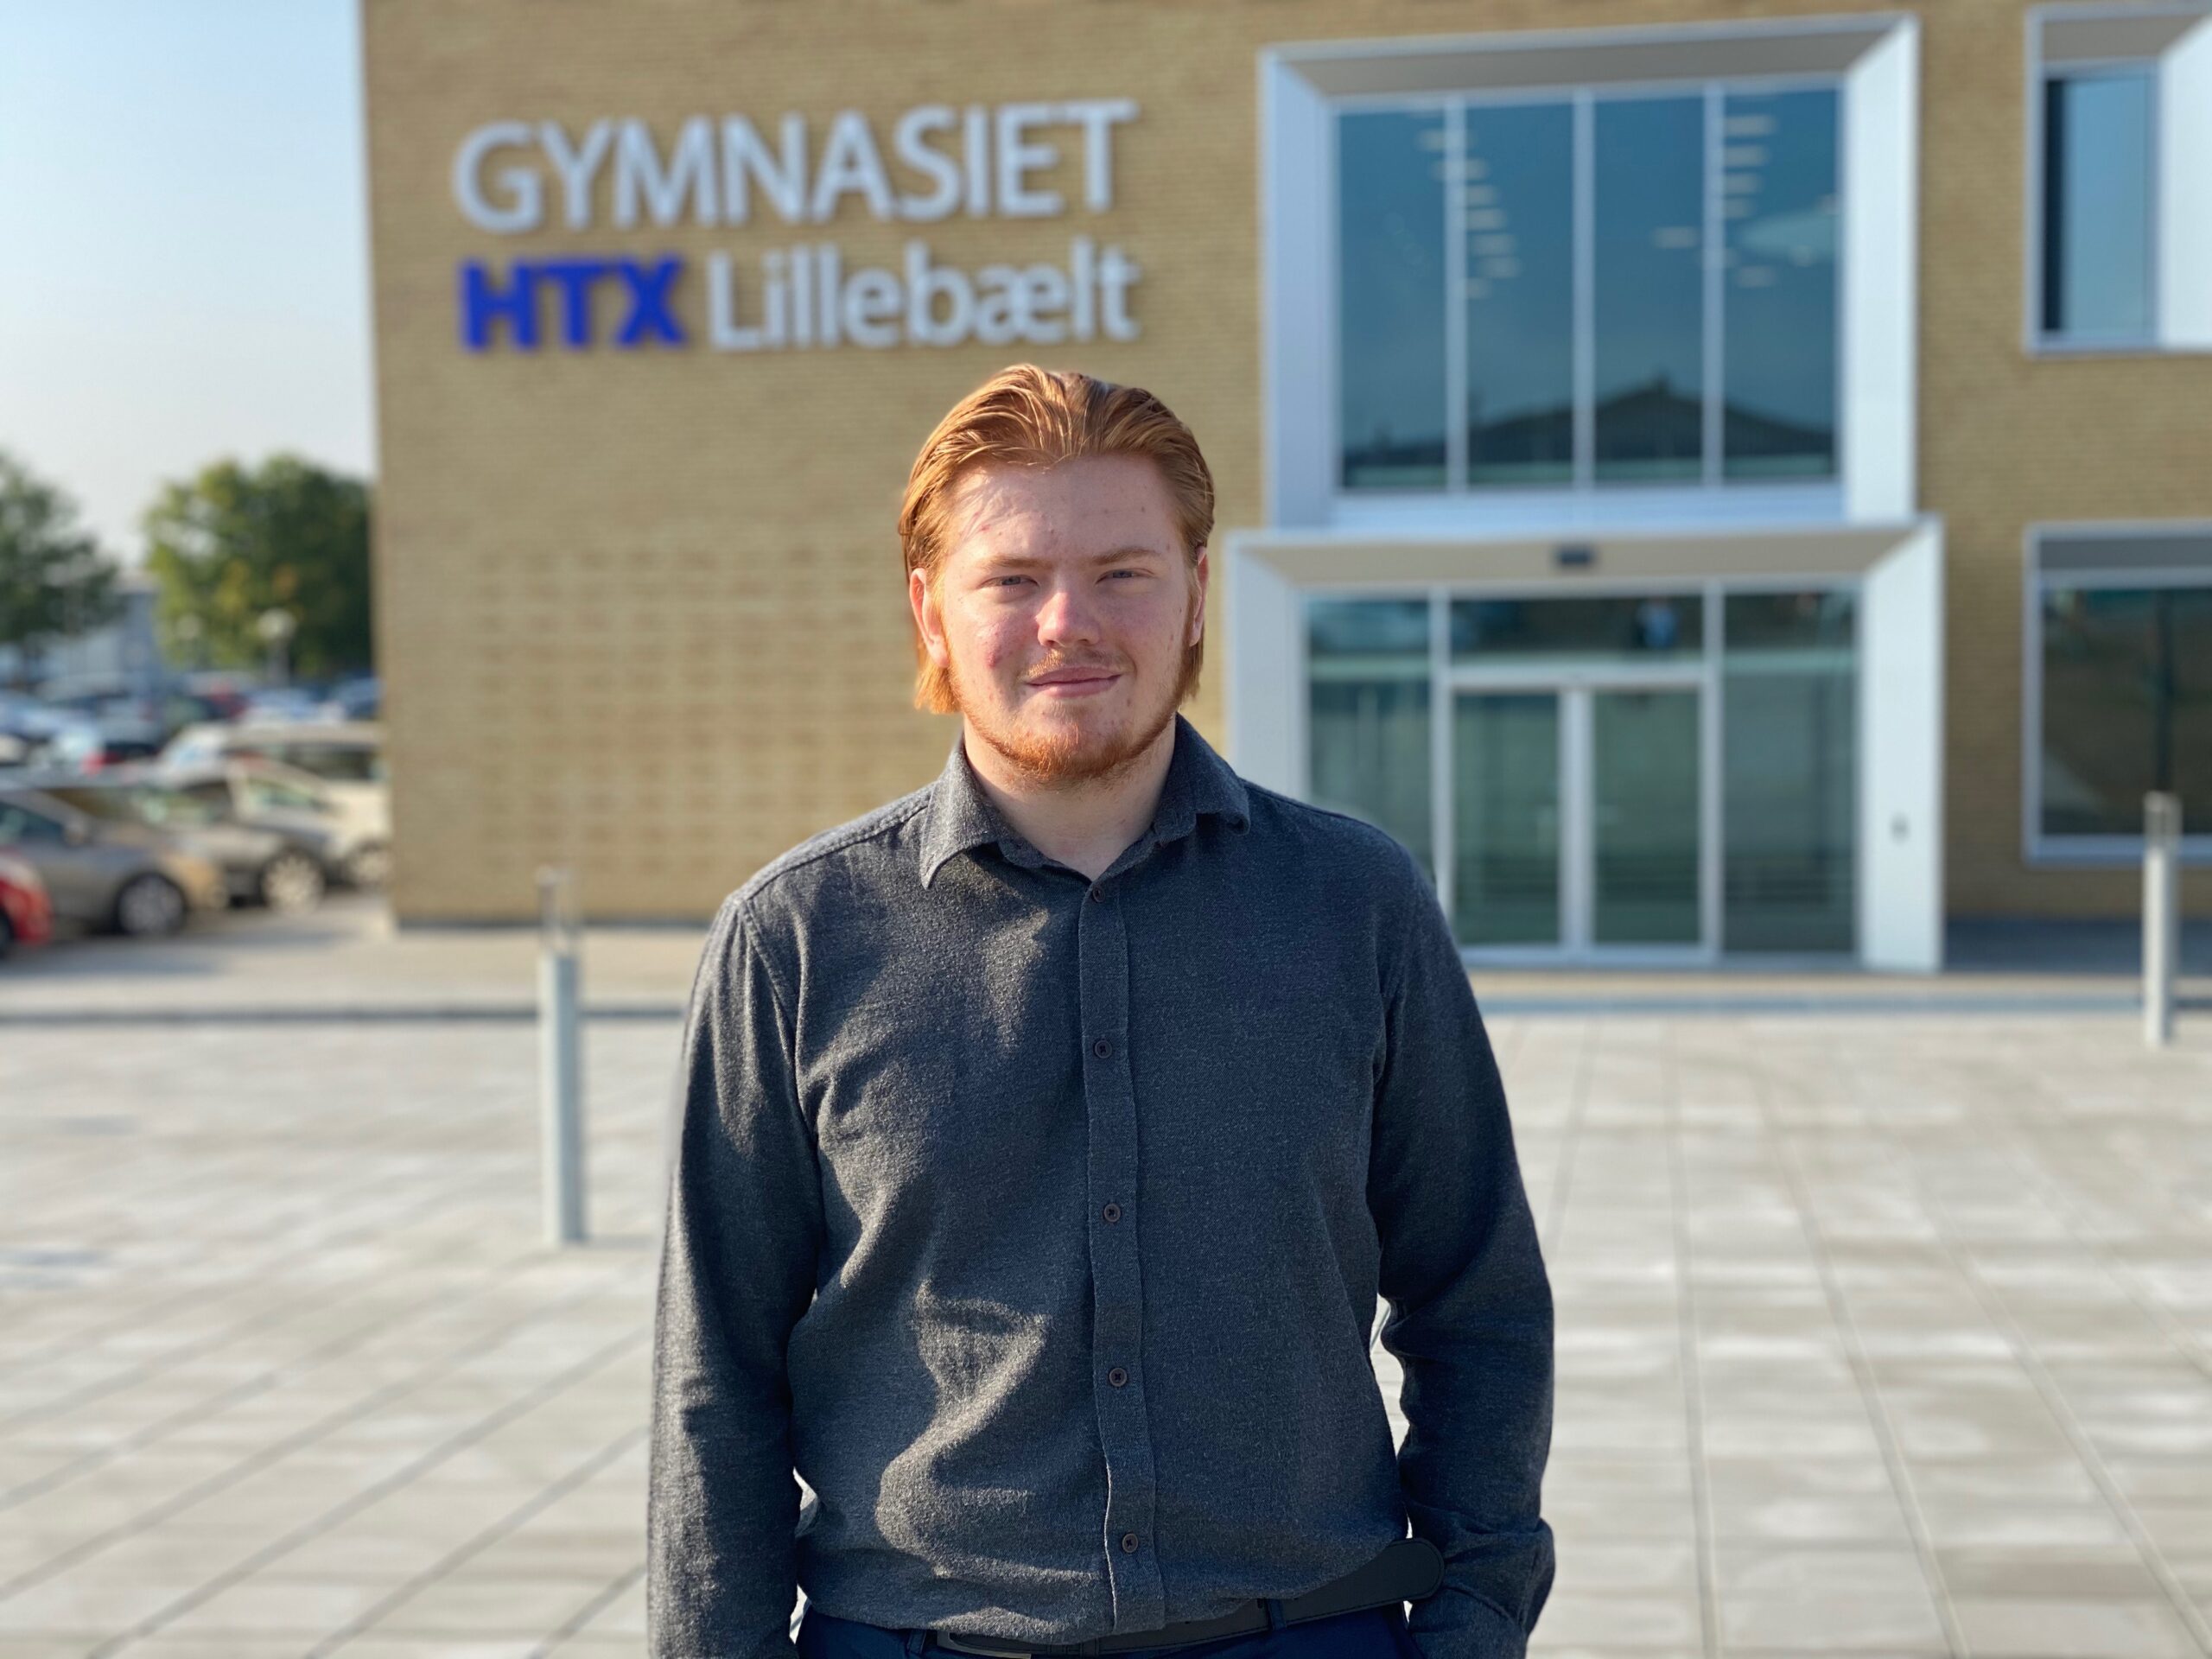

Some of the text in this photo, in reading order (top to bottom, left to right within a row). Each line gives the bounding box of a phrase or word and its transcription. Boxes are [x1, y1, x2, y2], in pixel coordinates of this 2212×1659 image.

[452, 98, 1139, 234] GYMNASIET
[457, 235, 1141, 353] HTX Lillebælt
